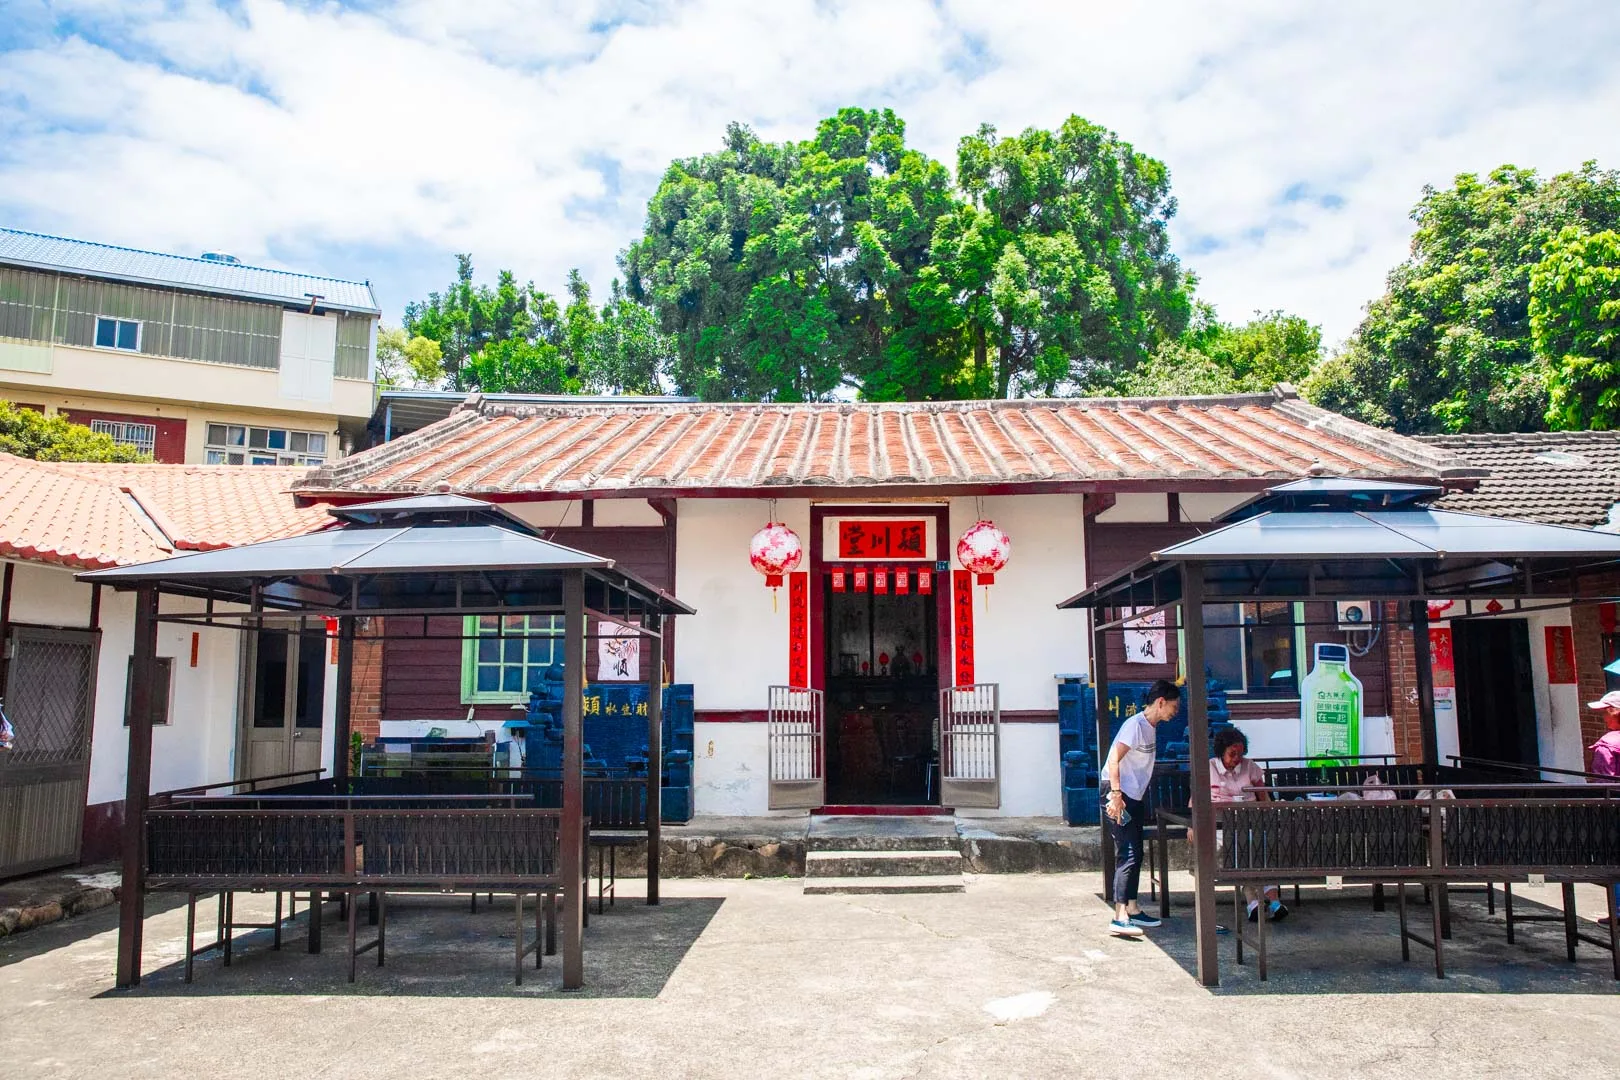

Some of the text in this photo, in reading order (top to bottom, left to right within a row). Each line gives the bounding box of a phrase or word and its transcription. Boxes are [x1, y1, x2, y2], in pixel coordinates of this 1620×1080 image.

[613, 658, 629, 676] 順
[1317, 713, 1347, 723] 在一起
